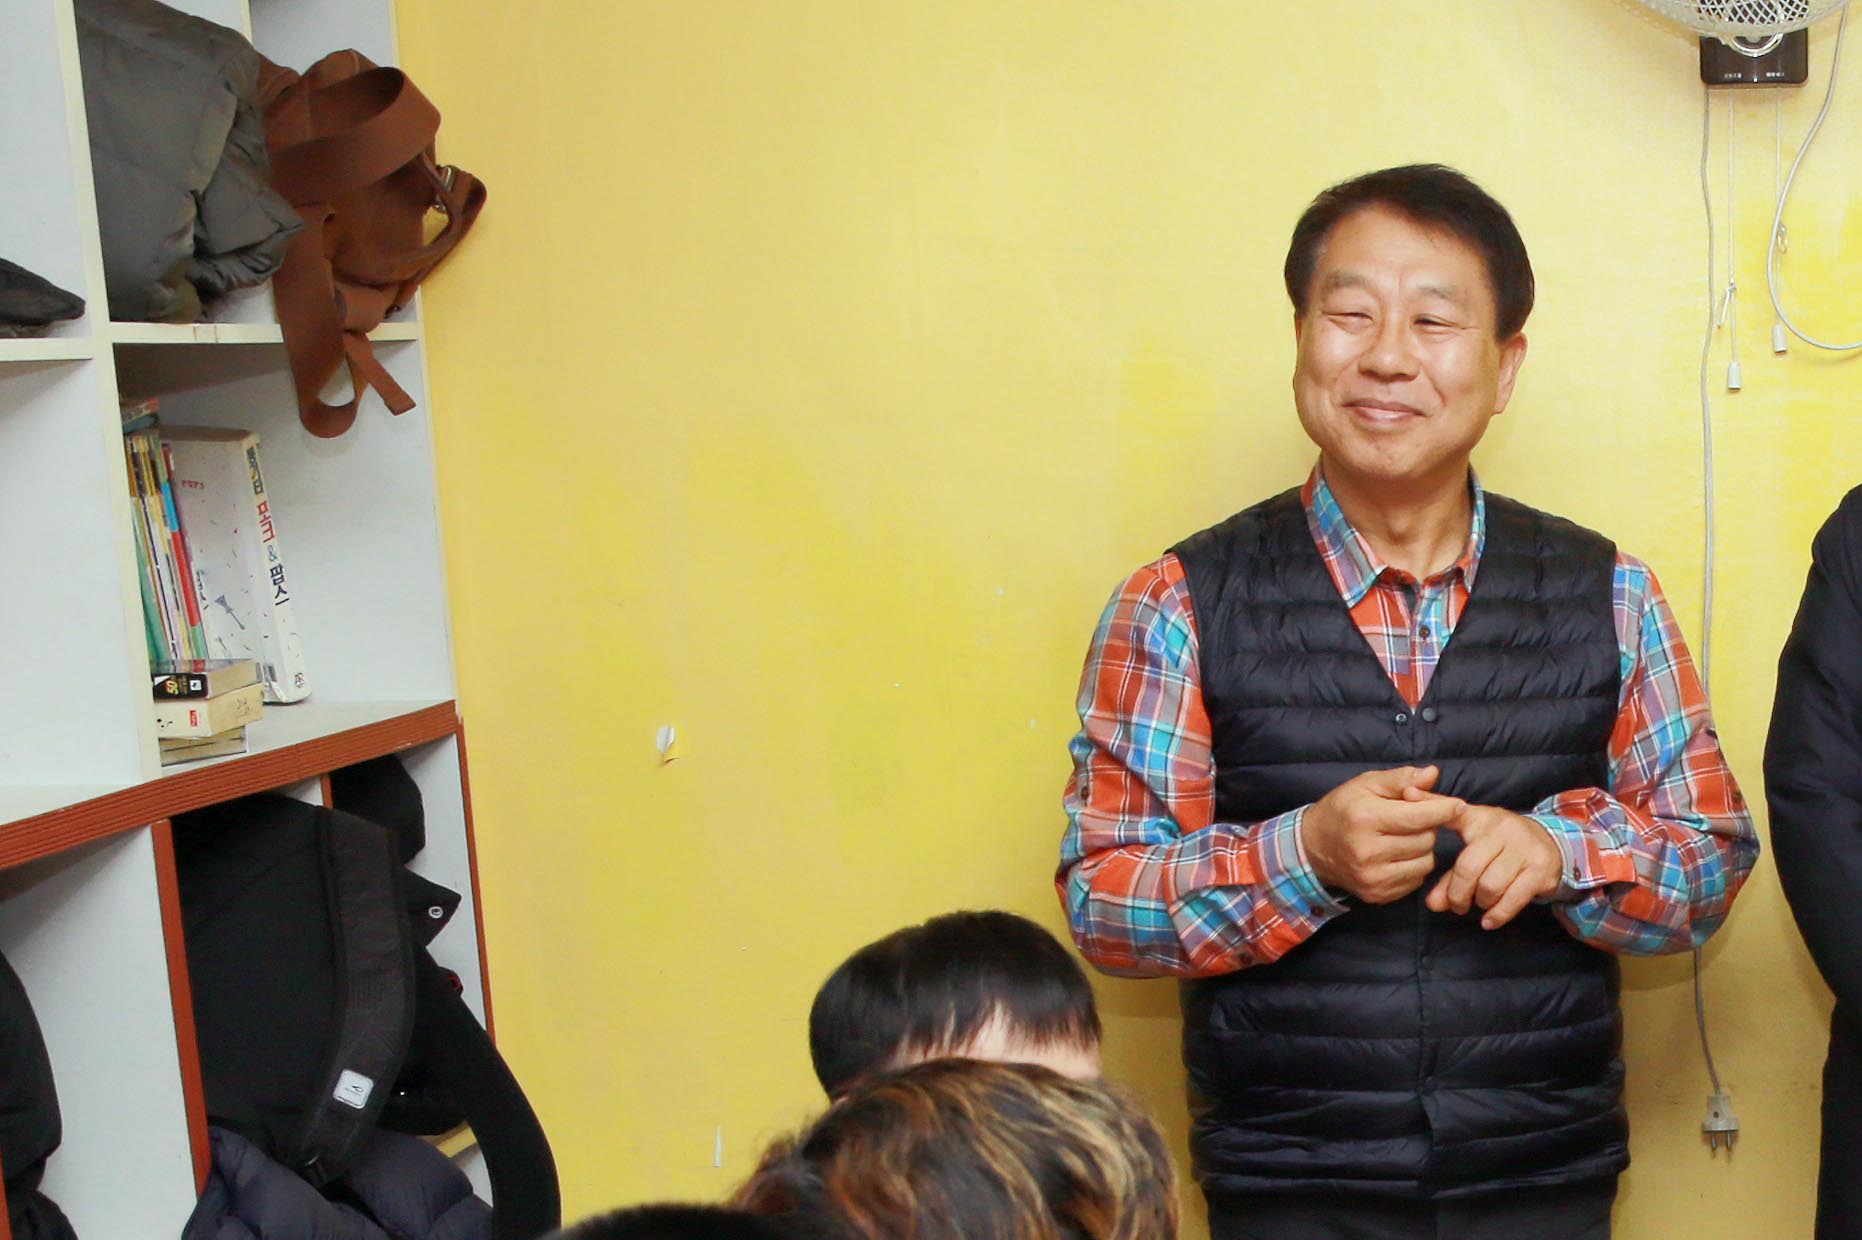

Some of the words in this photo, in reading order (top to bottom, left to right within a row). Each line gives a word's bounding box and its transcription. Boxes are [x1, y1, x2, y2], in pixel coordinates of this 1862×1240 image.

[256, 500, 276, 543] 포크
[267, 545, 278, 562] &
[269, 563, 290, 606] 팝스
